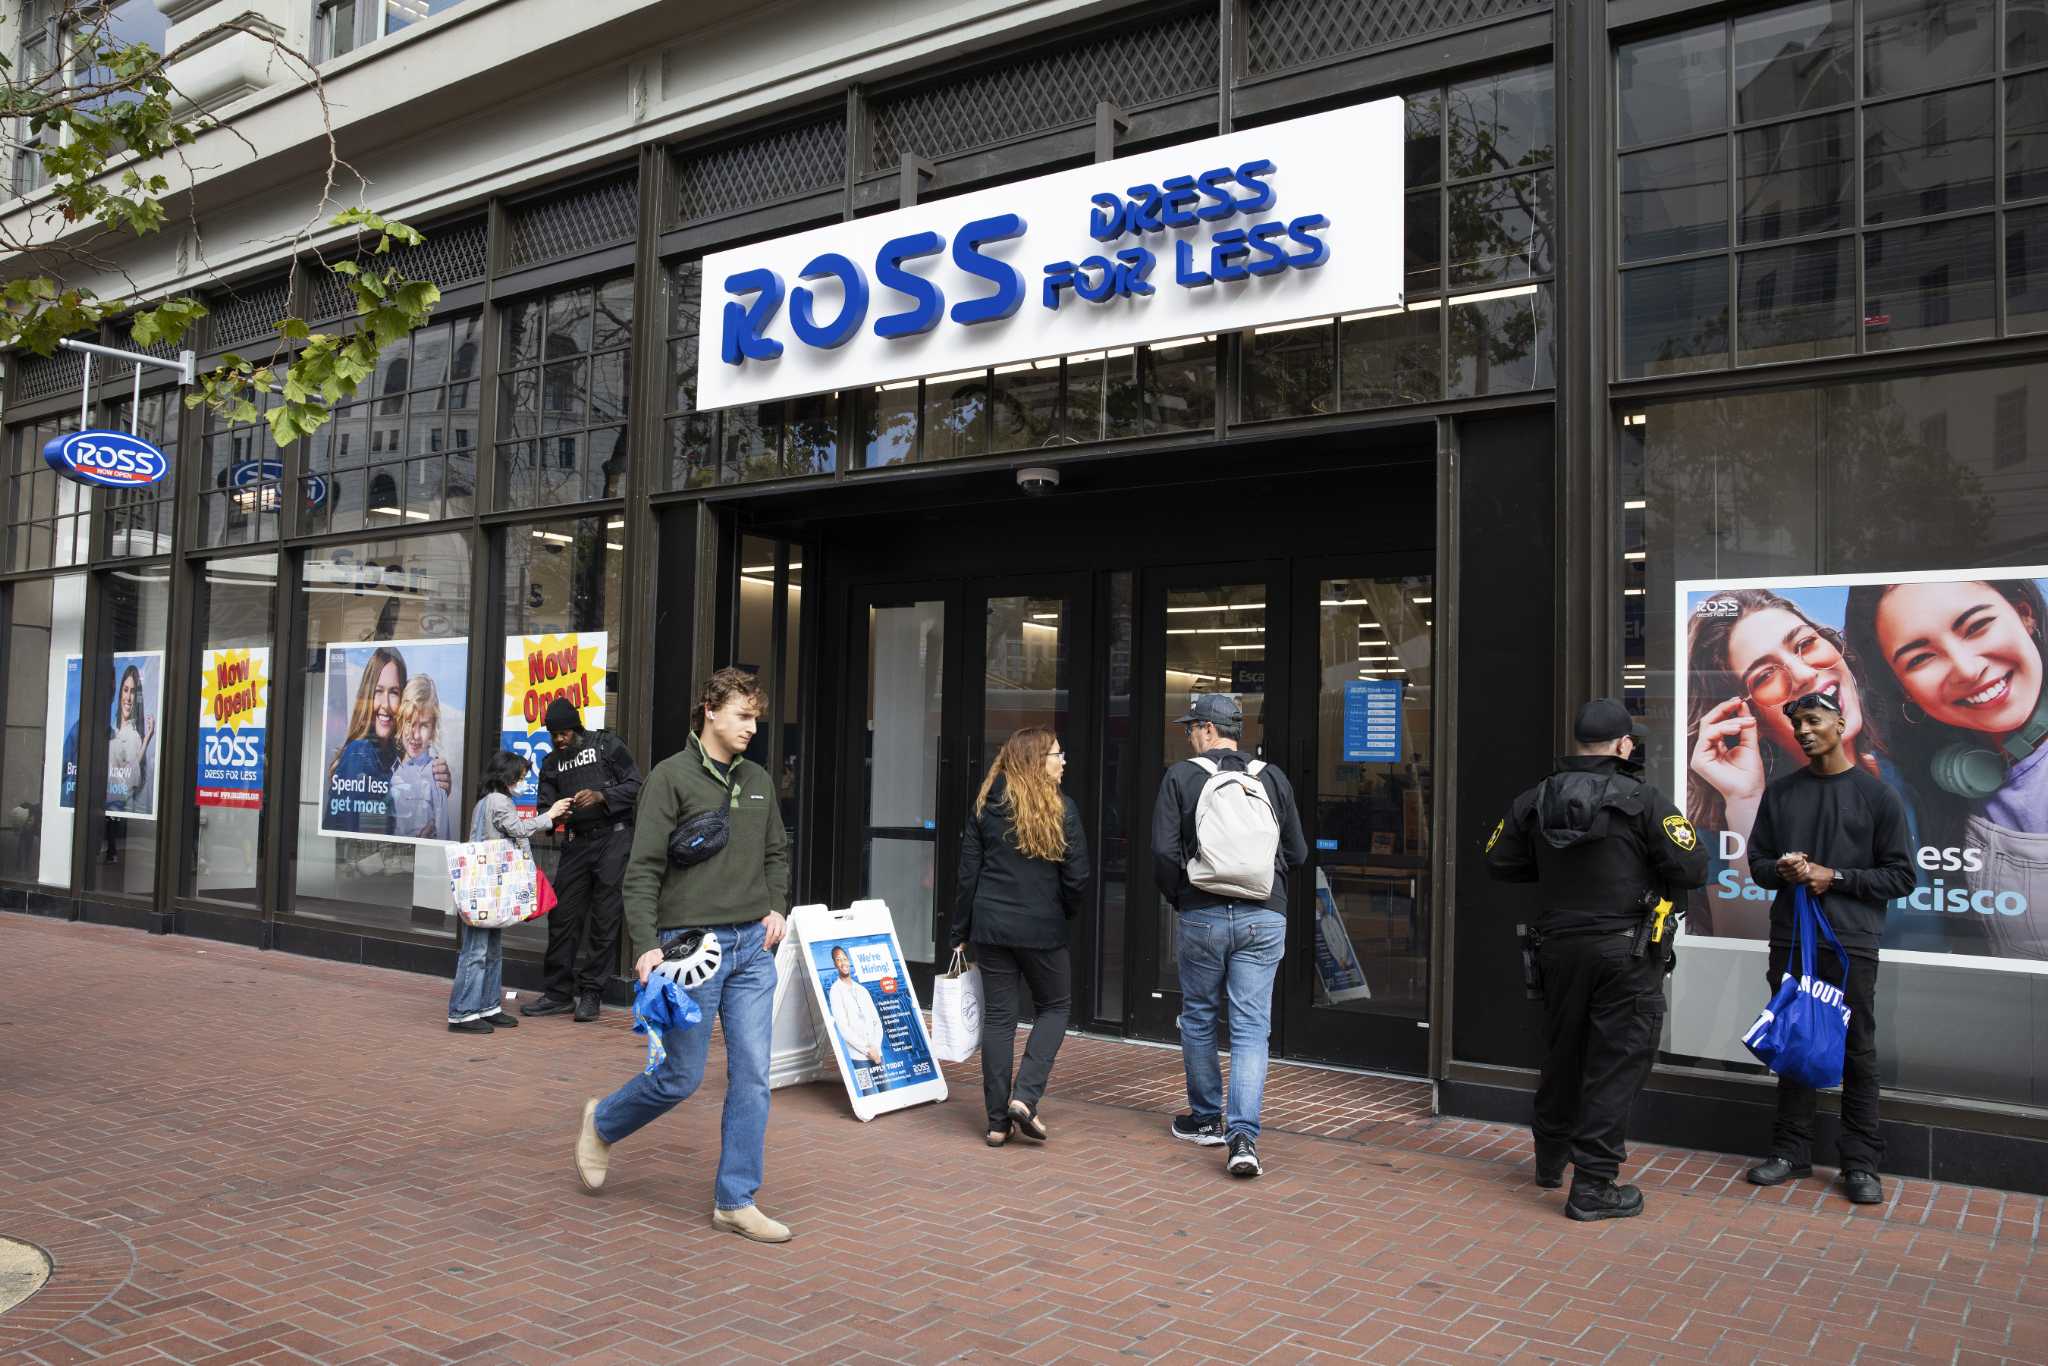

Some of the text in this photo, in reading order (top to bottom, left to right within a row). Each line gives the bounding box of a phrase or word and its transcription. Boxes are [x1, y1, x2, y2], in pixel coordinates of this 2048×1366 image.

[1090, 159, 1277, 243] DRESS
[1042, 213, 1331, 311] FOR LESS
[721, 213, 1028, 366] ROSS
[76, 441, 154, 475] ROSS
[113, 471, 132, 479] OPEN
[1696, 600, 1739, 612] ROSS
[217, 658, 250, 690] Now
[528, 645, 579, 686] Now
[214, 680, 256, 724] Open!
[205, 735, 259, 767] ROSS
[109, 767, 133, 778] know
[204, 769, 257, 781] DRESS FOR LESS
[332, 774, 389, 796] Spend less
[330, 796, 386, 815] get more
[1916, 844, 1983, 873] ess
[1896, 878, 2027, 916] cisco
[857, 953, 881, 964] We're
[861, 964, 890, 976] Hiring!
